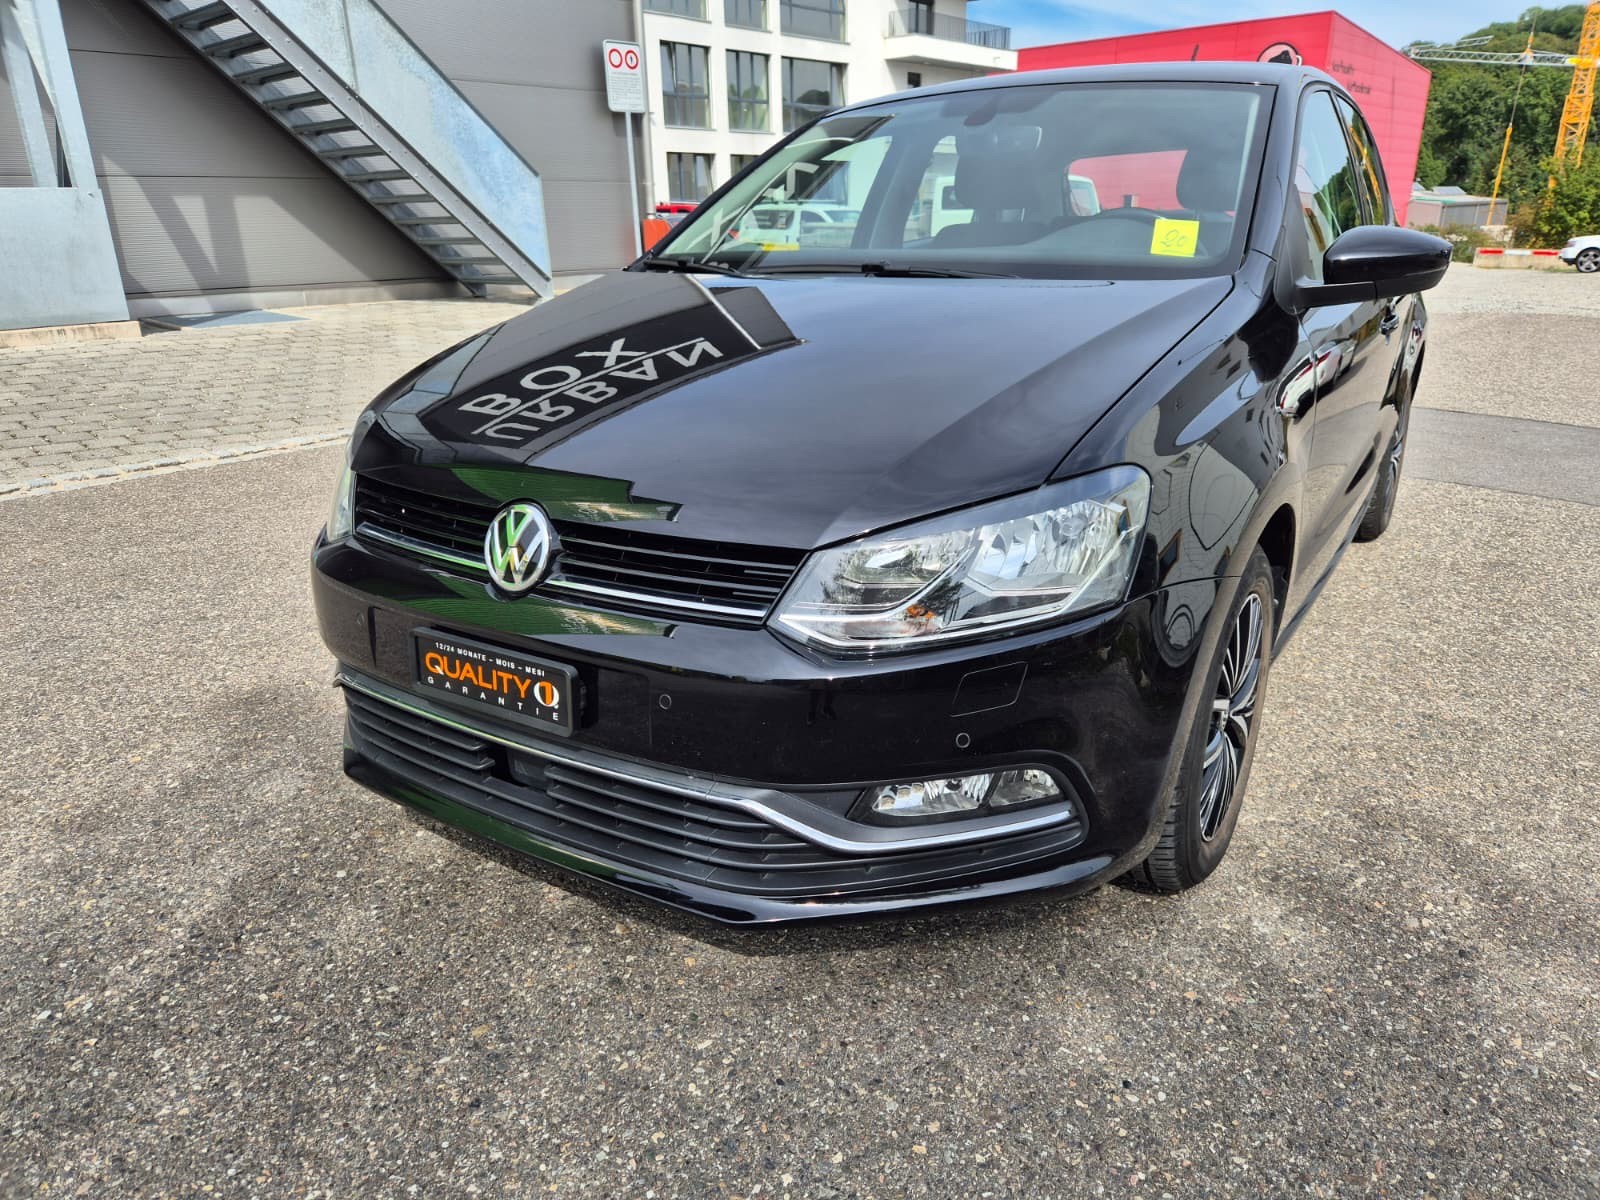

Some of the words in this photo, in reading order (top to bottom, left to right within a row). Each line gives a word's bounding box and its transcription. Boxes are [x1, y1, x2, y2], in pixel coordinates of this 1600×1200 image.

[457, 649, 487, 662] MONATE
[495, 658, 515, 669] MOIS
[525, 665, 545, 677] MESI
[427, 676, 559, 721] GARANTIE
